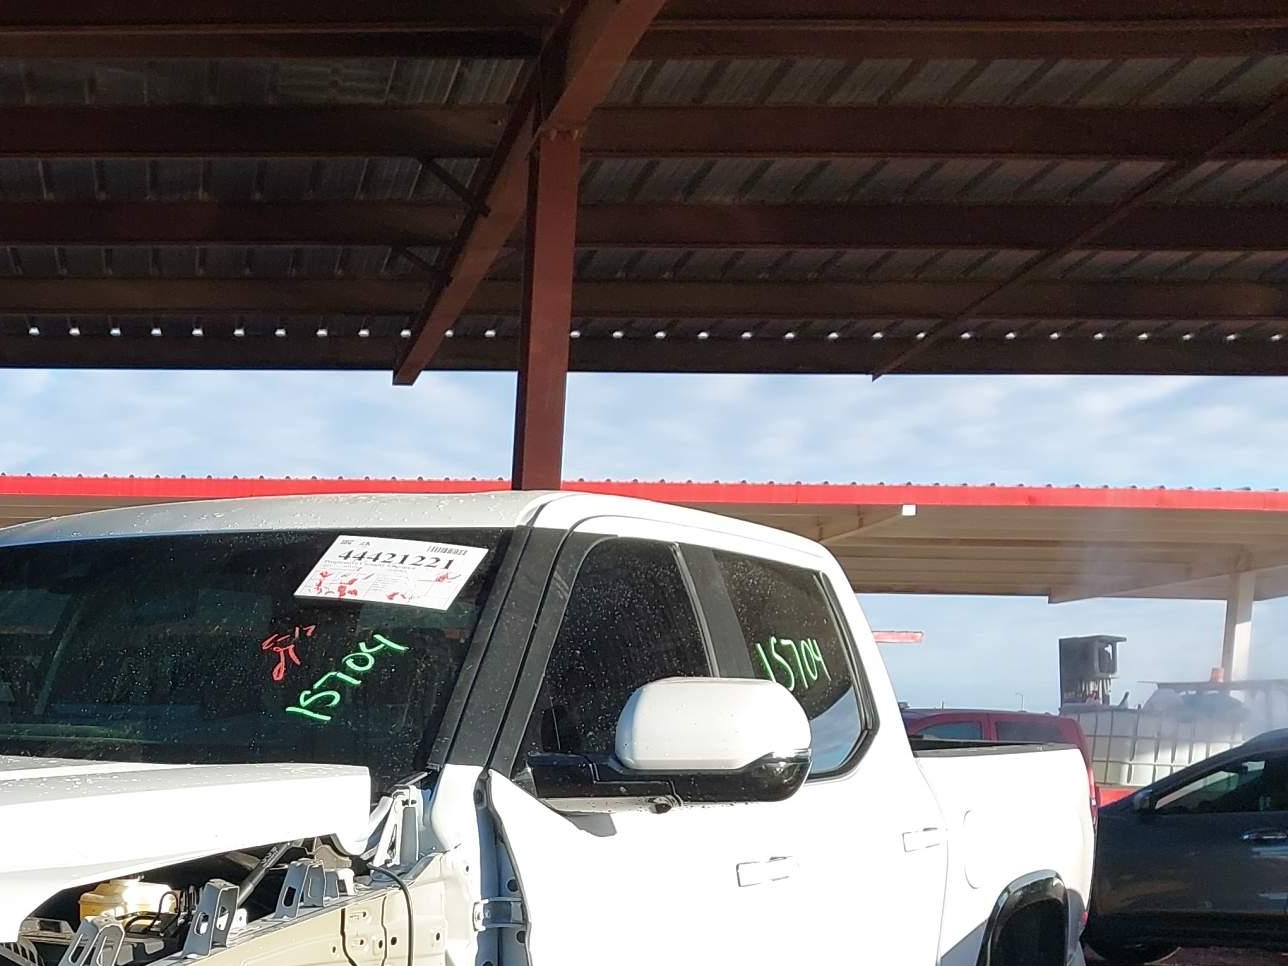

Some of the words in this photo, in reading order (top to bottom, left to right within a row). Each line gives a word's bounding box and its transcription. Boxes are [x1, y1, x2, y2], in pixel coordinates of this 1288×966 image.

[338, 549, 454, 570] 44421221
[285, 633, 410, 721] 15704
[755, 636, 832, 691] 15704
